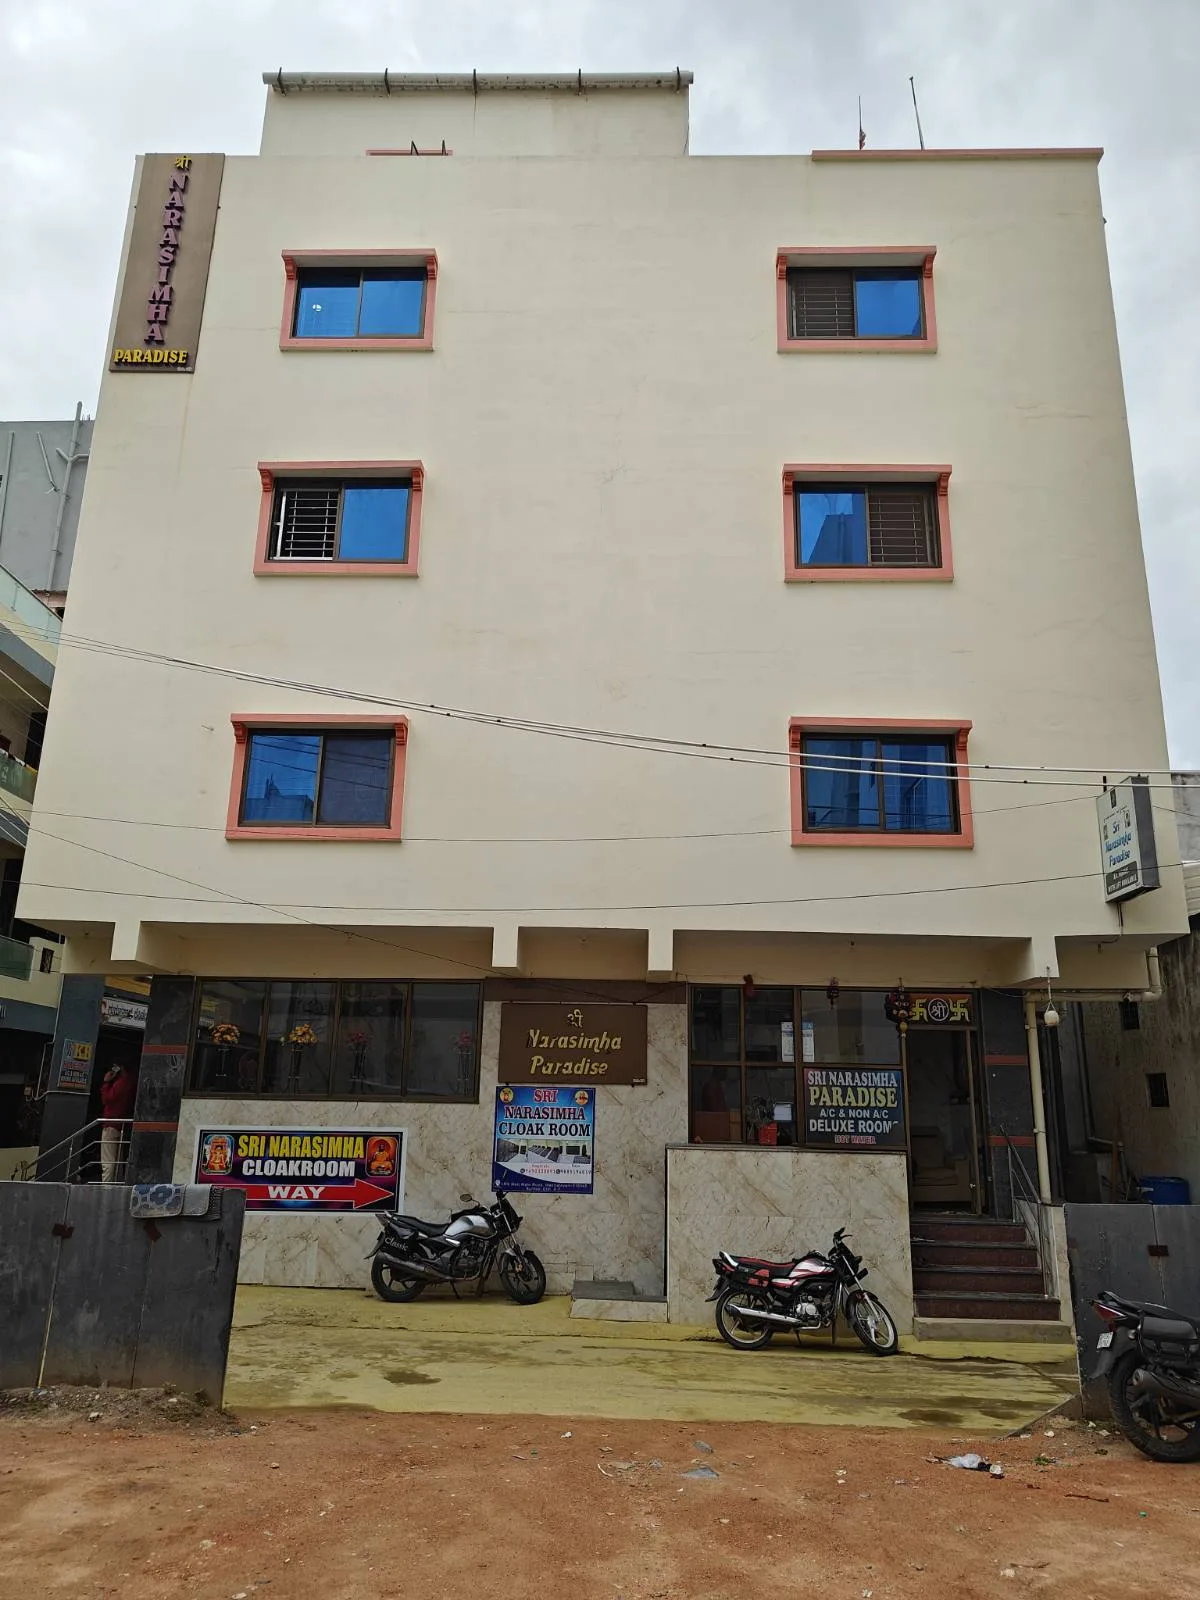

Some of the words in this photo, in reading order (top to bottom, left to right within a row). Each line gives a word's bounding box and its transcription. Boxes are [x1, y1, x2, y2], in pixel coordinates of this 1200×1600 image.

[145, 173, 188, 345] NARASIMHA
[114, 349, 188, 364] PARADISE
[1112, 820, 1120, 834] Sri
[930, 1001, 947, 1018] श्री
[567, 1009, 584, 1028] श्री
[529, 1029, 622, 1053] Narasimha
[529, 1055, 608, 1076] Paradise
[807, 1071, 827, 1085] SRI
[829, 1071, 898, 1087] NARASIMHA
[533, 1089, 558, 1103] SRI
[809, 1086, 898, 1108] PARADISE
[504, 1106, 585, 1121] NARASIMHA
[820, 1109, 835, 1118] A/C
[839, 1109, 846, 1118] &
[848, 1109, 870, 1119] NON
[873, 1110, 889, 1119] A/C
[499, 1122, 545, 1136] CLOAK
[549, 1123, 591, 1137] ROOM
[809, 1119, 854, 1133] DELUXE
[237, 1135, 265, 1158] SRI
[268, 1136, 364, 1159] NARASIMHA
[242, 1159, 356, 1177] CLOAKROOM
[267, 1186, 326, 1199] WAY
